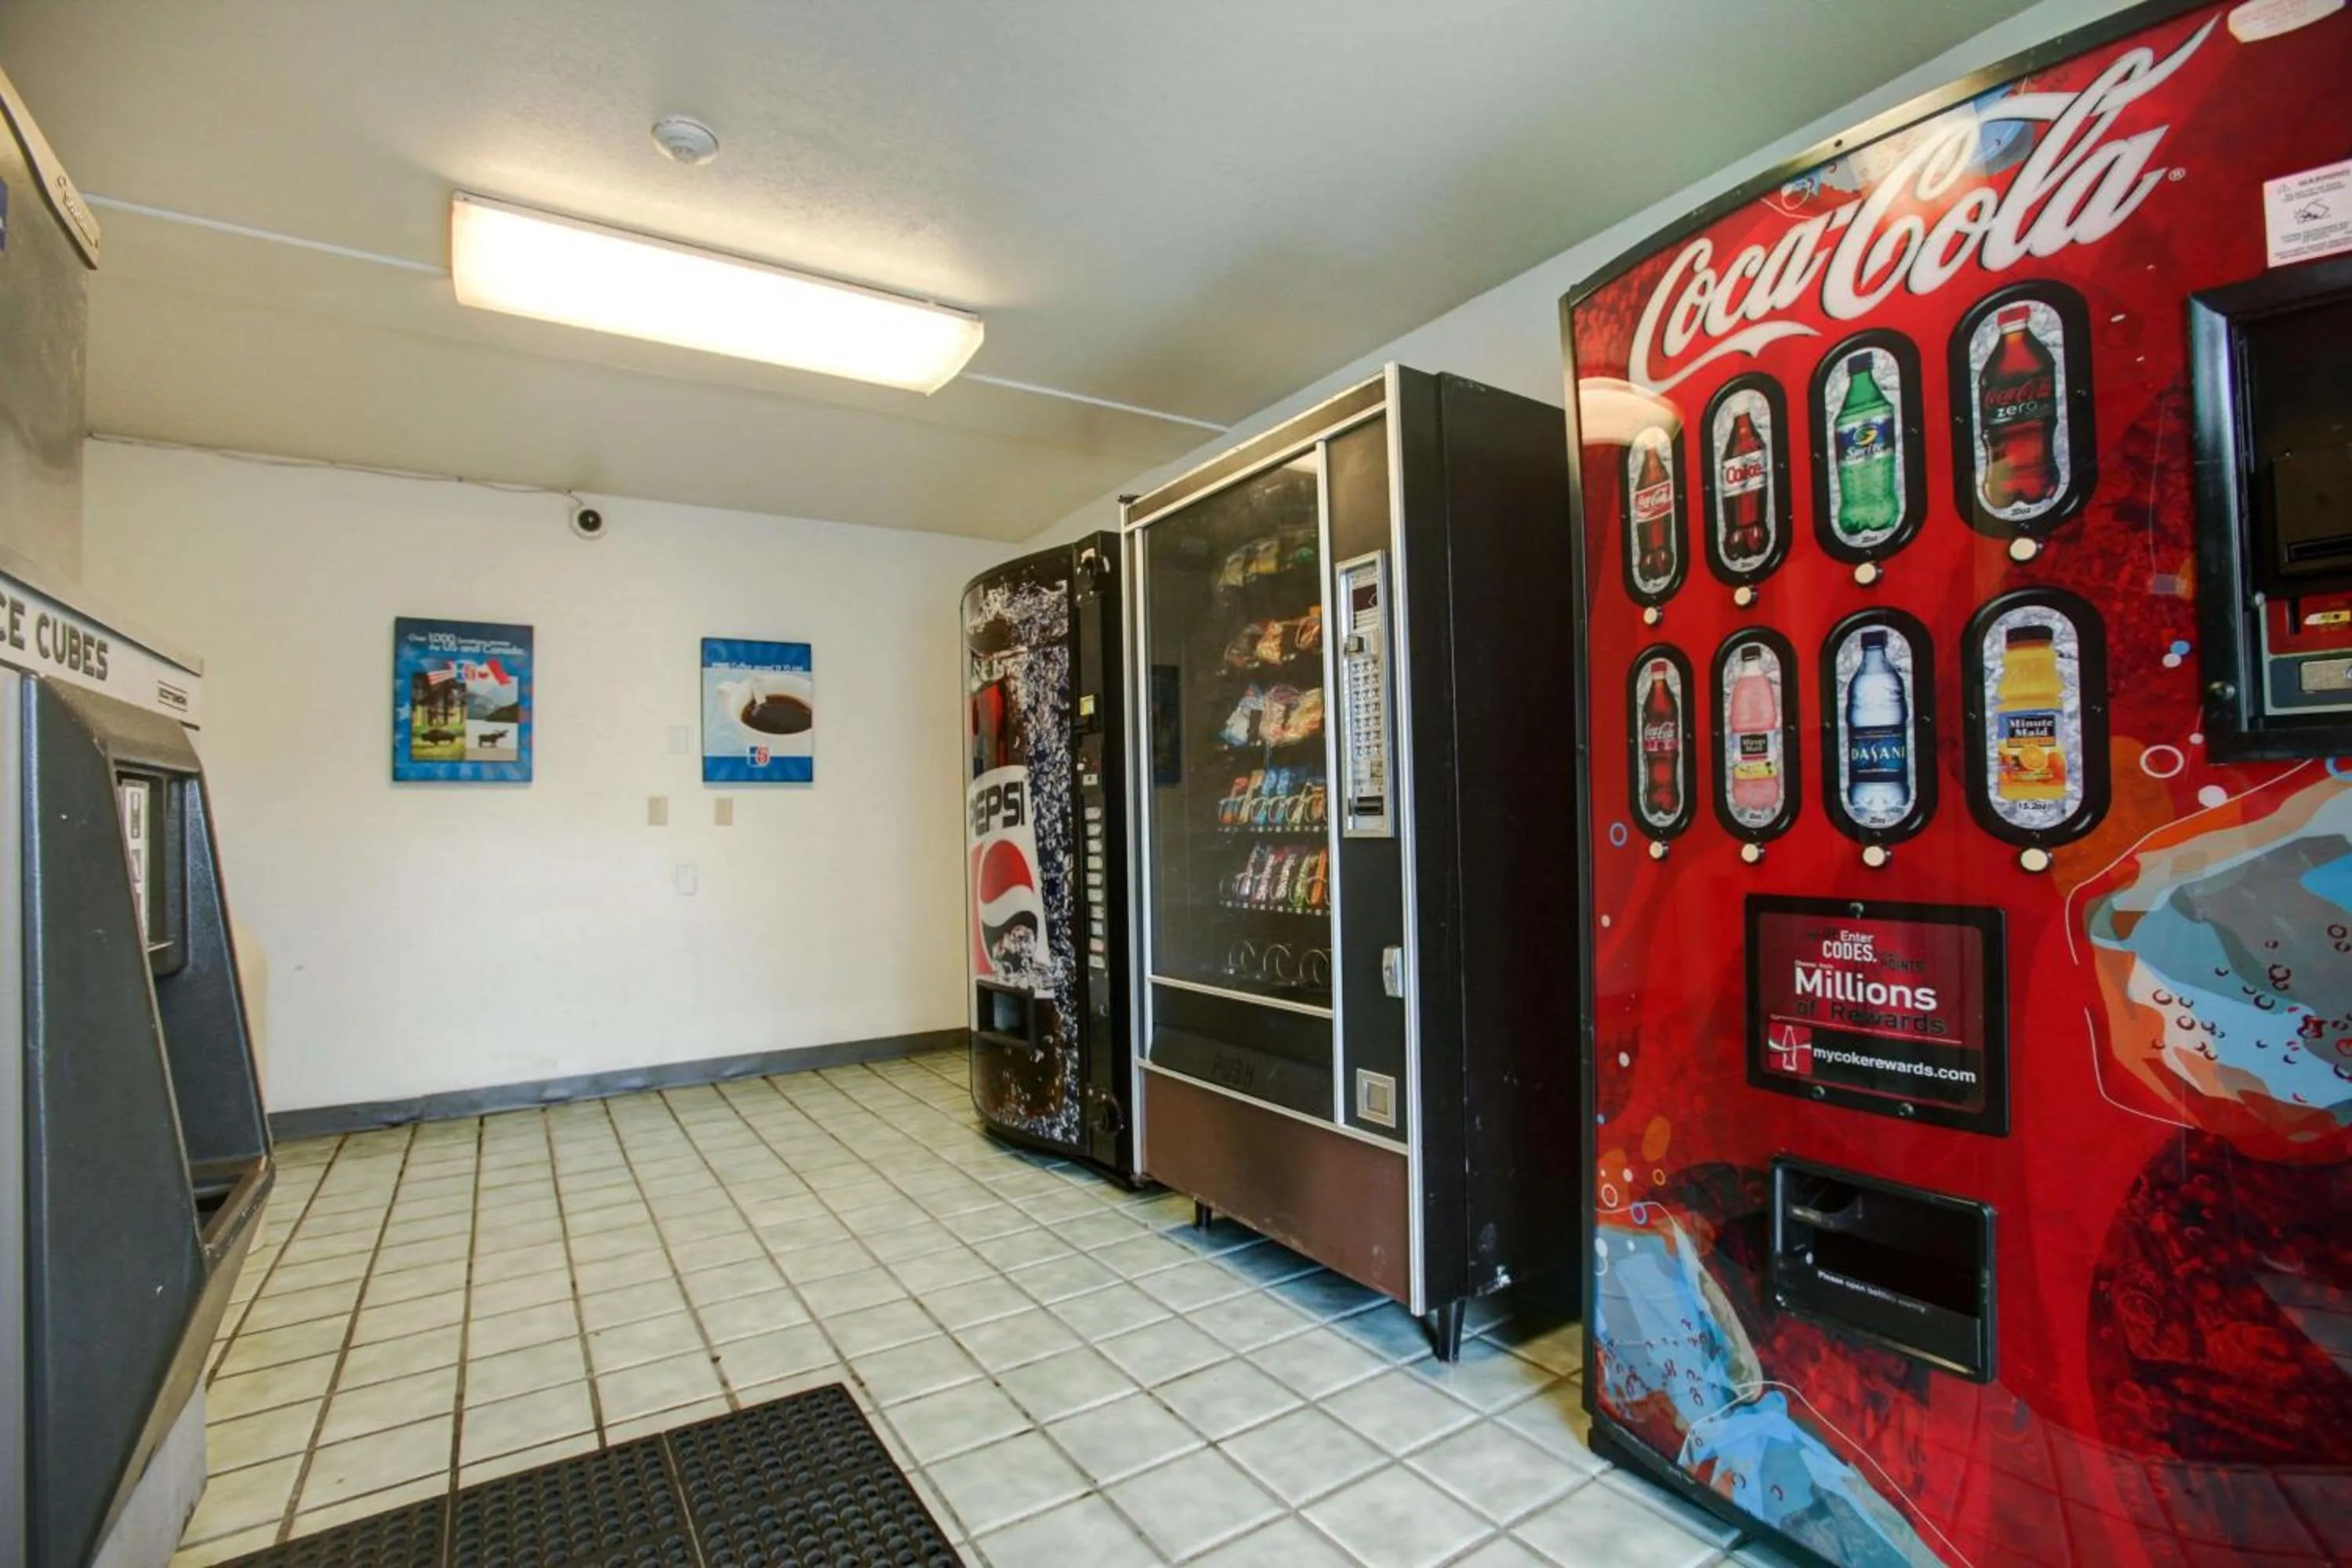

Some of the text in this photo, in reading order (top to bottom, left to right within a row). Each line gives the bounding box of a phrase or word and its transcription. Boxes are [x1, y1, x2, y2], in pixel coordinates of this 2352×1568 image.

[1628, 13, 2220, 394] Coca-Cola
[1996, 401, 2038, 418] zero
[1847, 443, 1885, 459] Sprite
[1726, 463, 1762, 485] Coke
[36, 612, 108, 681] CUBES
[2009, 718, 2054, 729] Minute
[2014, 728, 2048, 737] Maid
[1851, 745, 1906, 764] DASANI
[1839, 930, 1875, 944] Enter
[1822, 940, 1878, 964] CODES.
[1795, 966, 1938, 1011] Millions
[1795, 1000, 1947, 1034] of Rewards
[1813, 1047, 1977, 1083] mycokerewards.com
